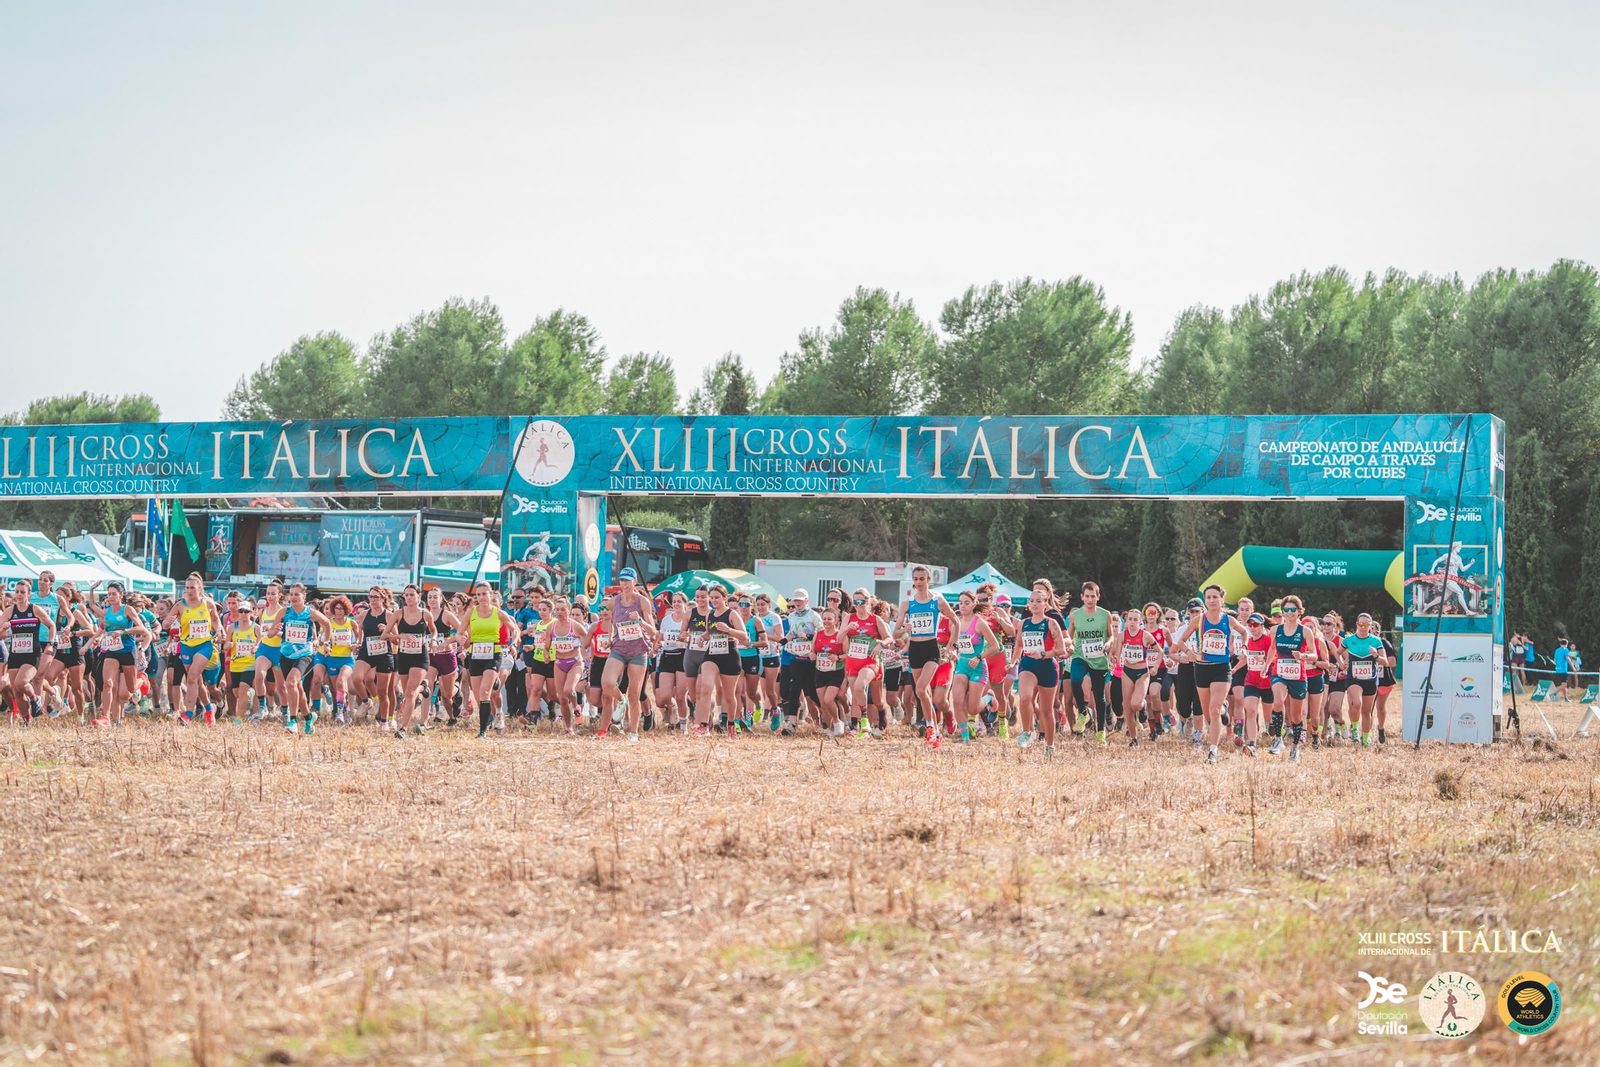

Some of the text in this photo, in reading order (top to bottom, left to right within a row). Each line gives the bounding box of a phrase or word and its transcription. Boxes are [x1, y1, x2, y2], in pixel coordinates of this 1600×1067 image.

[743, 428, 847, 455] CROSS
[1258, 438, 1469, 454] CAMPEONATO DE ANDALUCÍA
[80, 434, 169, 461] CROSS
[211, 419, 438, 480] ITÁLICA
[610, 427, 741, 473] XLIII
[896, 415, 1163, 480] ITÁLICA
[1291, 451, 1436, 466] DE CAMPO A TRAVÉS
[80, 462, 203, 477] INTERNACIONAL
[743, 458, 886, 473] INTERNACIONAL
[1323, 467, 1406, 479] POR CLUBES
[73, 480, 113, 493] CROSS
[115, 479, 180, 493] COUNTRY
[609, 476, 860, 491] INTERNATIONAL CROSS COUNTRY
[540, 505, 567, 513] Sevilla
[1449, 513, 1482, 522] Sevilla
[1317, 559, 1347, 568] Diputación
[1317, 566, 1347, 576] Sevilla
[912, 619, 932, 628] 1317
[287, 630, 306, 638] 1412
[620, 628, 640, 636] 1425
[13, 640, 32, 648] 1499
[369, 642, 386, 650] 1337
[402, 641, 420, 649] 1501
[1024, 639, 1042, 647] 1314
[1205, 641, 1225, 650] 1487
[473, 646, 492, 654] 1217
[794, 644, 811, 652] 1174
[850, 646, 867, 654] 1281
[1124, 651, 1142, 659] 1146
[818, 660, 835, 668] 1257
[1279, 666, 1300, 675] 1460
